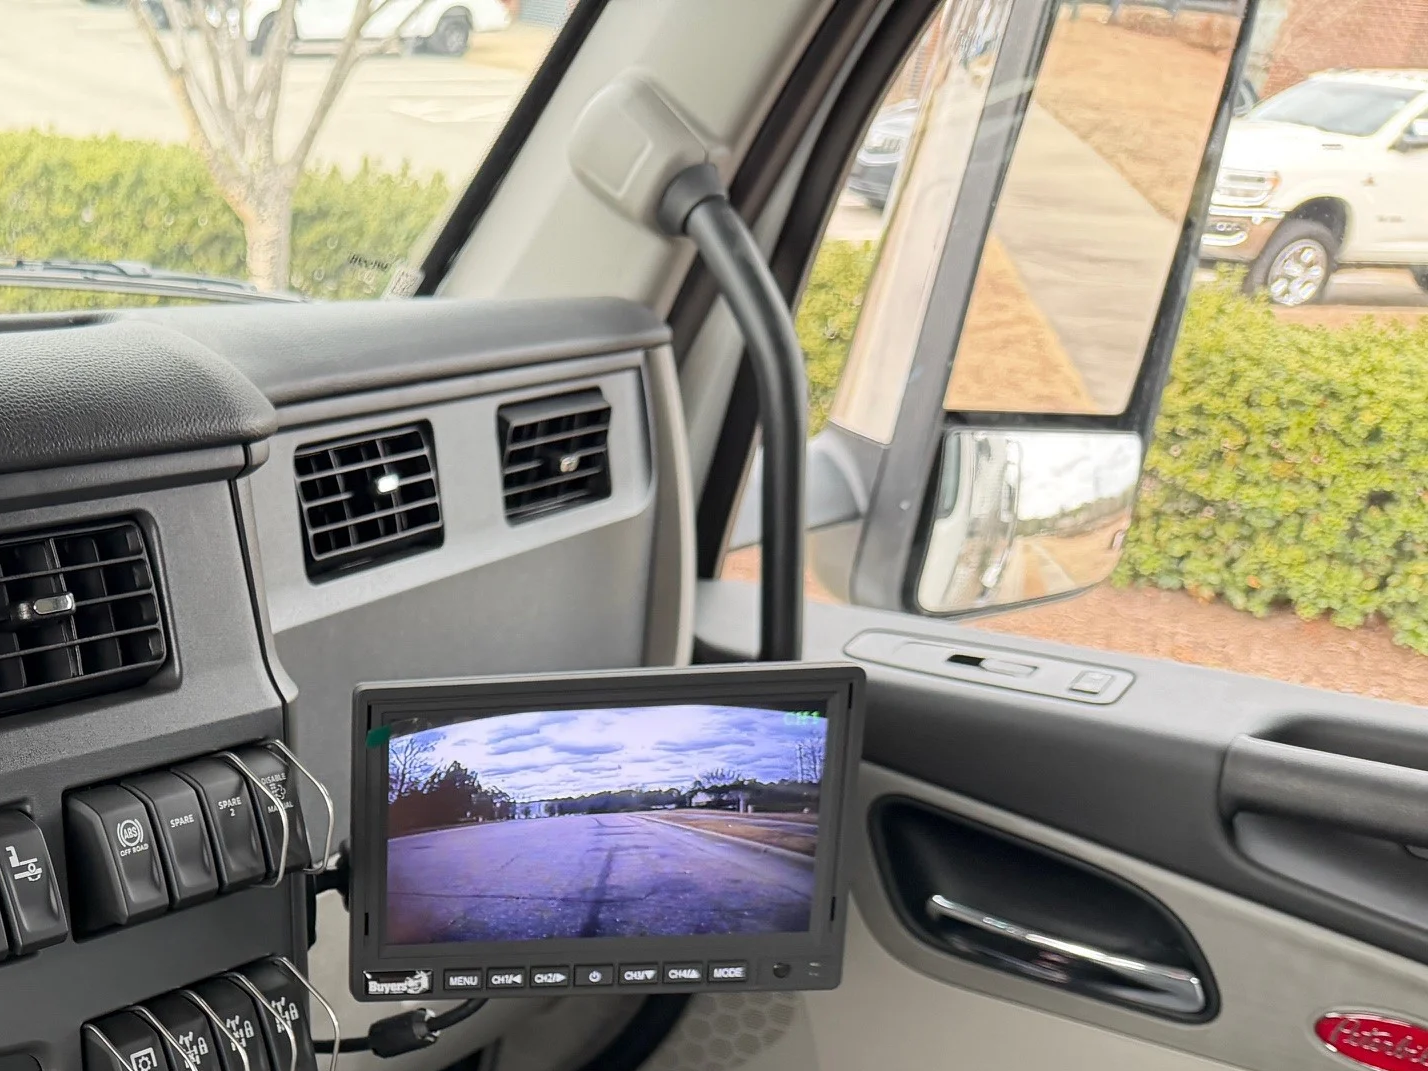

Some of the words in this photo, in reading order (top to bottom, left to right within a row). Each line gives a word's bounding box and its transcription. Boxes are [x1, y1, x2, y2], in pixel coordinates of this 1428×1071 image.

[218, 796, 242, 810] SPARE
[229, 808, 236, 817] 2
[170, 814, 194, 828] SPARE
[123, 826, 138, 839] ABS
[713, 967, 746, 978] MODE
[368, 981, 407, 994] Buyers
[449, 976, 478, 986] MENU
